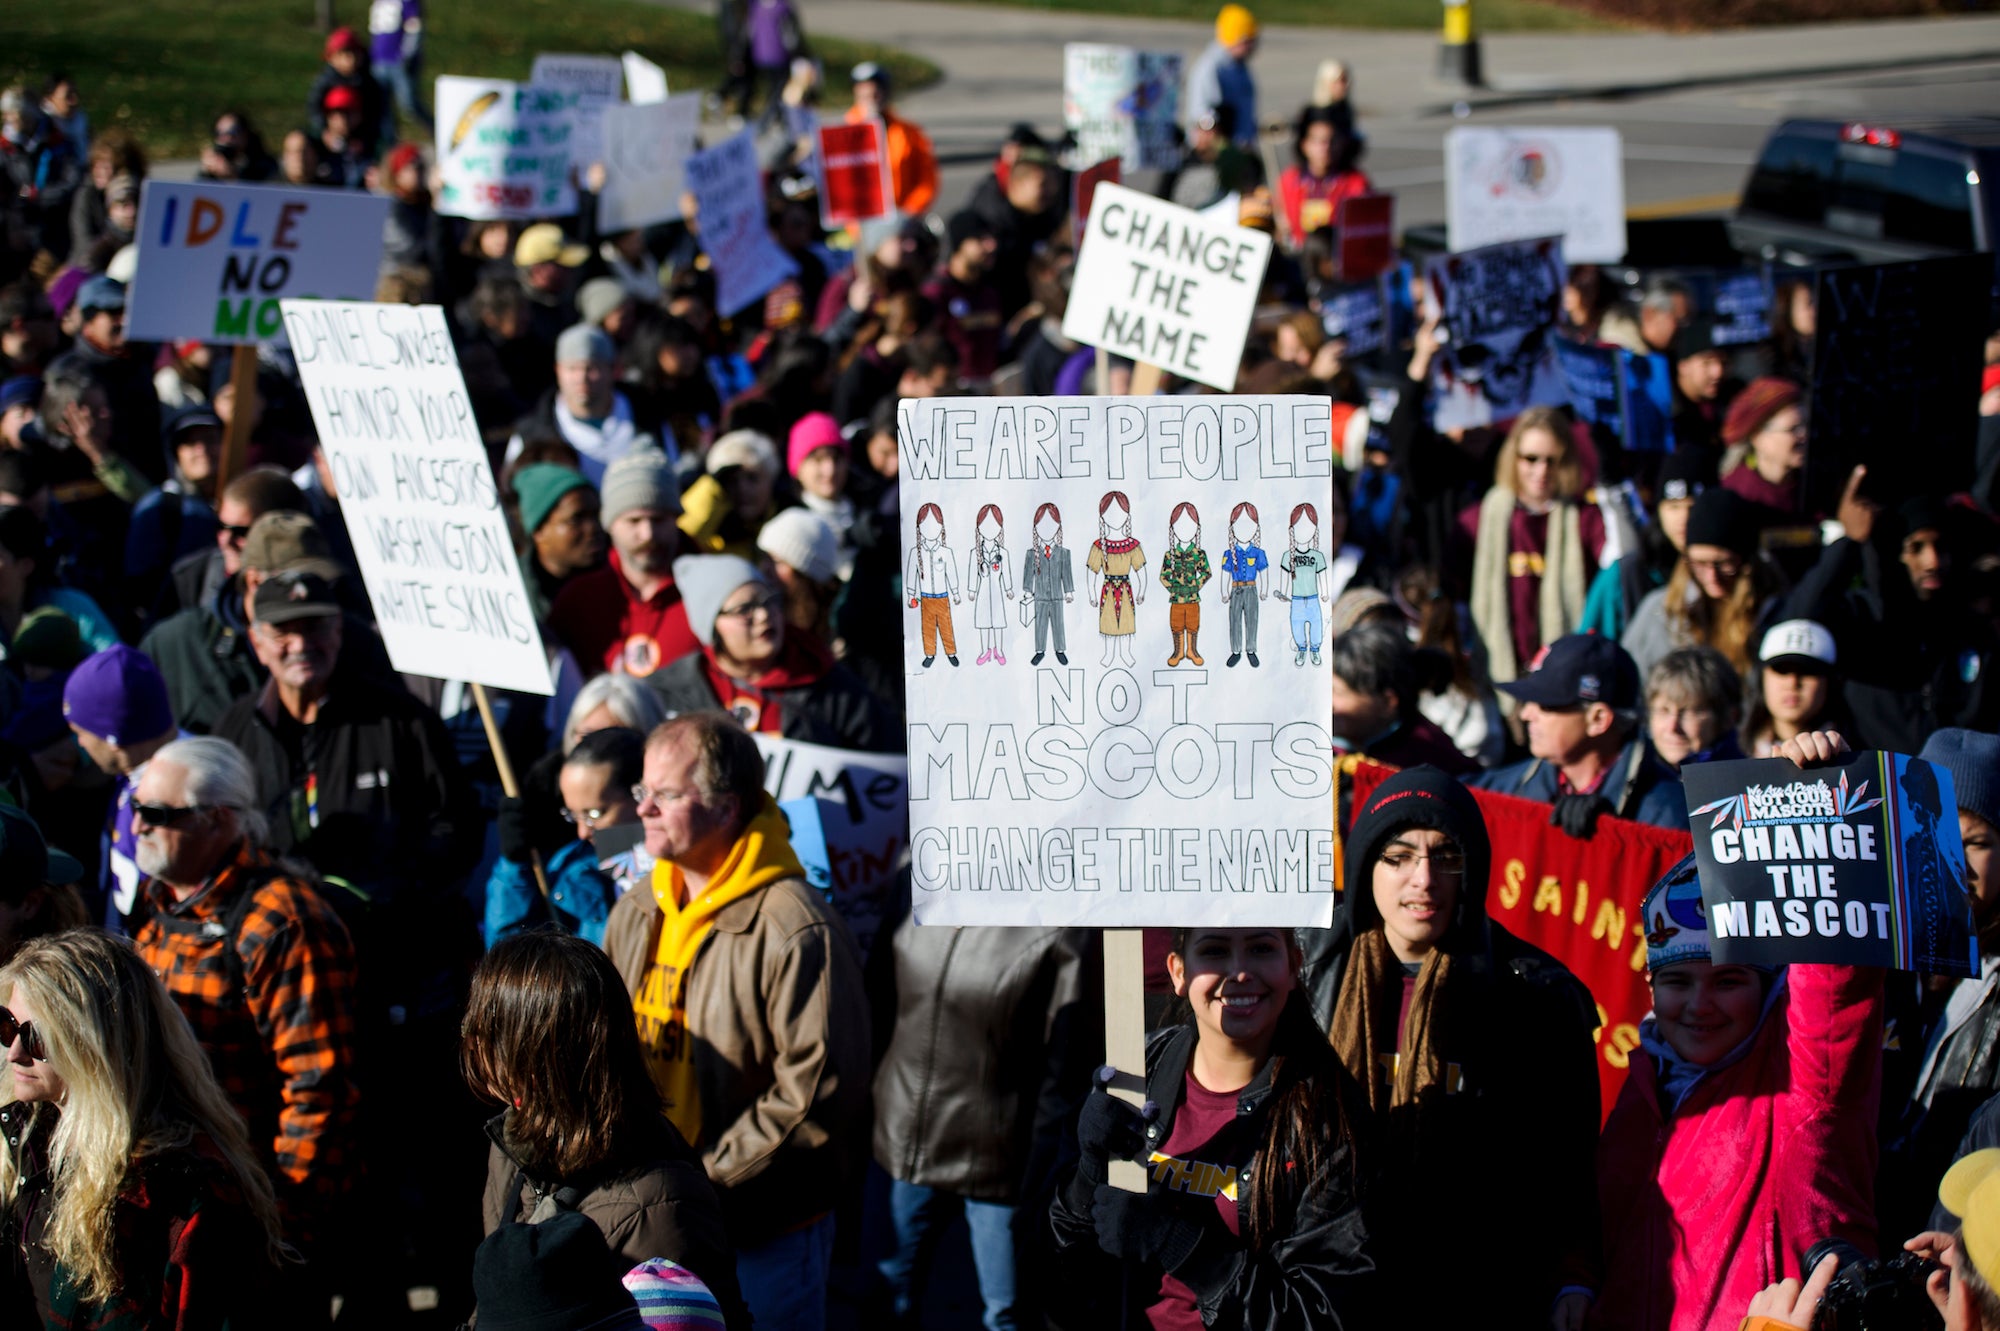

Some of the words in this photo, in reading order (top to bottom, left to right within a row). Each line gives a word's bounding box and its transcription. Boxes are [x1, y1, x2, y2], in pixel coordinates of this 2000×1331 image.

[160, 195, 309, 248] IDLE
[1100, 203, 1255, 283] CHANGE
[220, 254, 291, 294] NO
[1130, 261, 1198, 317] THE
[284, 309, 386, 369] DANIEL
[1101, 305, 1208, 372] NAME
[320, 386, 413, 441] HONOR
[407, 386, 479, 446] YOUR
[898, 407, 976, 480] WE
[985, 405, 1091, 479] ARE
[1106, 404, 1330, 481] PEOPLE
[392, 452, 499, 511] ANCESTORS
[365, 515, 509, 576] WASHINGTON
[446, 584, 530, 644] SKINS
[1036, 668, 1208, 726] NOT
[908, 721, 1333, 800] MASCOTS
[1746, 784, 1763, 796] We
[1794, 778, 1830, 793] People
[1743, 816, 1845, 827] WWW.NOTYOURMASCOTS.ORG
[1748, 792, 1785, 807] NOT
[1786, 789, 1833, 805] YOUR
[1750, 802, 1835, 820] MASCOTS
[910, 826, 1100, 891] CHANGE
[1106, 827, 1200, 892] THE
[1209, 828, 1334, 893] NAME
[1711, 823, 1878, 864] CHANGE
[1766, 865, 1838, 898] THE
[1712, 899, 1890, 939] MASCOT
